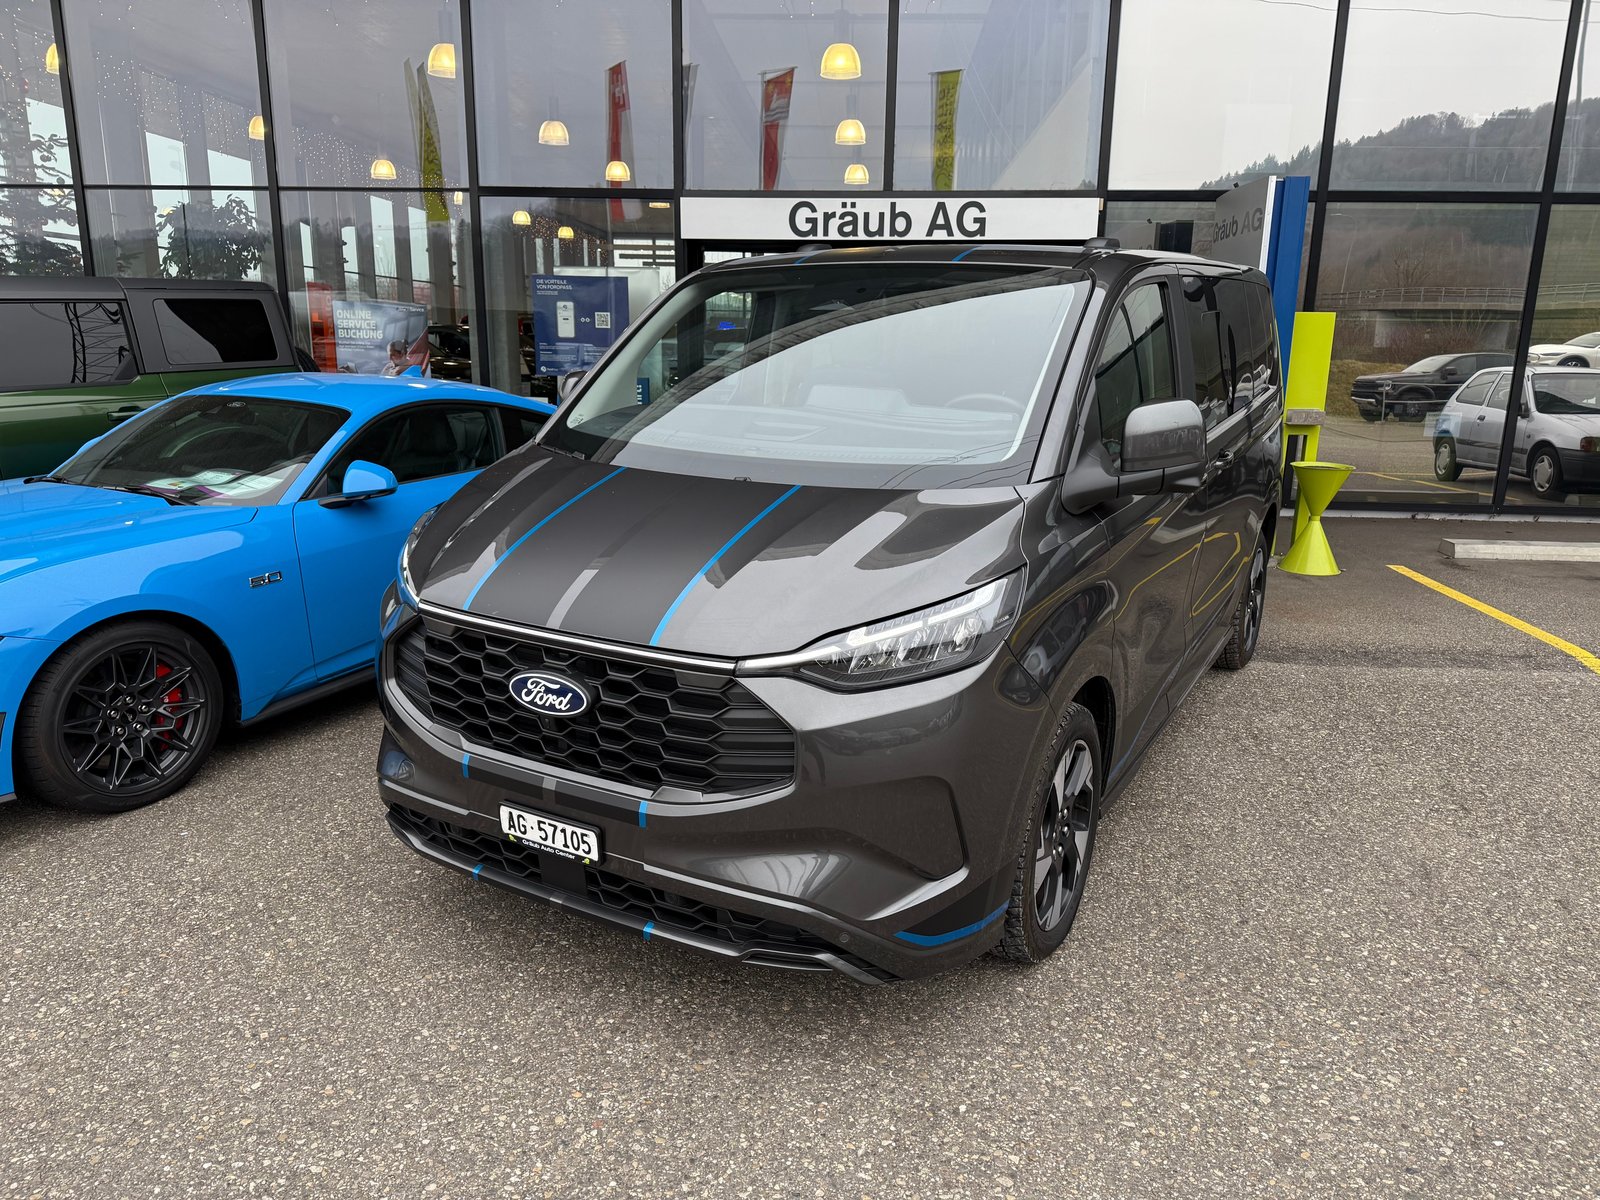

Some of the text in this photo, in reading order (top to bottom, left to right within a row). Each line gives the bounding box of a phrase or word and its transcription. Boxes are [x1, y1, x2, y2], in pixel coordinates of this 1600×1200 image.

[788, 200, 987, 238] Gräub AG
[1241, 207, 1263, 235] AG
[336, 310, 372, 319] ONLINE
[337, 319, 376, 329] SERVICE
[338, 329, 383, 339] BUCHUNG
[249, 570, 282, 588] 5.0
[521, 678, 572, 711] Ford
[541, 844, 555, 853] Auto
[555, 849, 575, 859] Center
